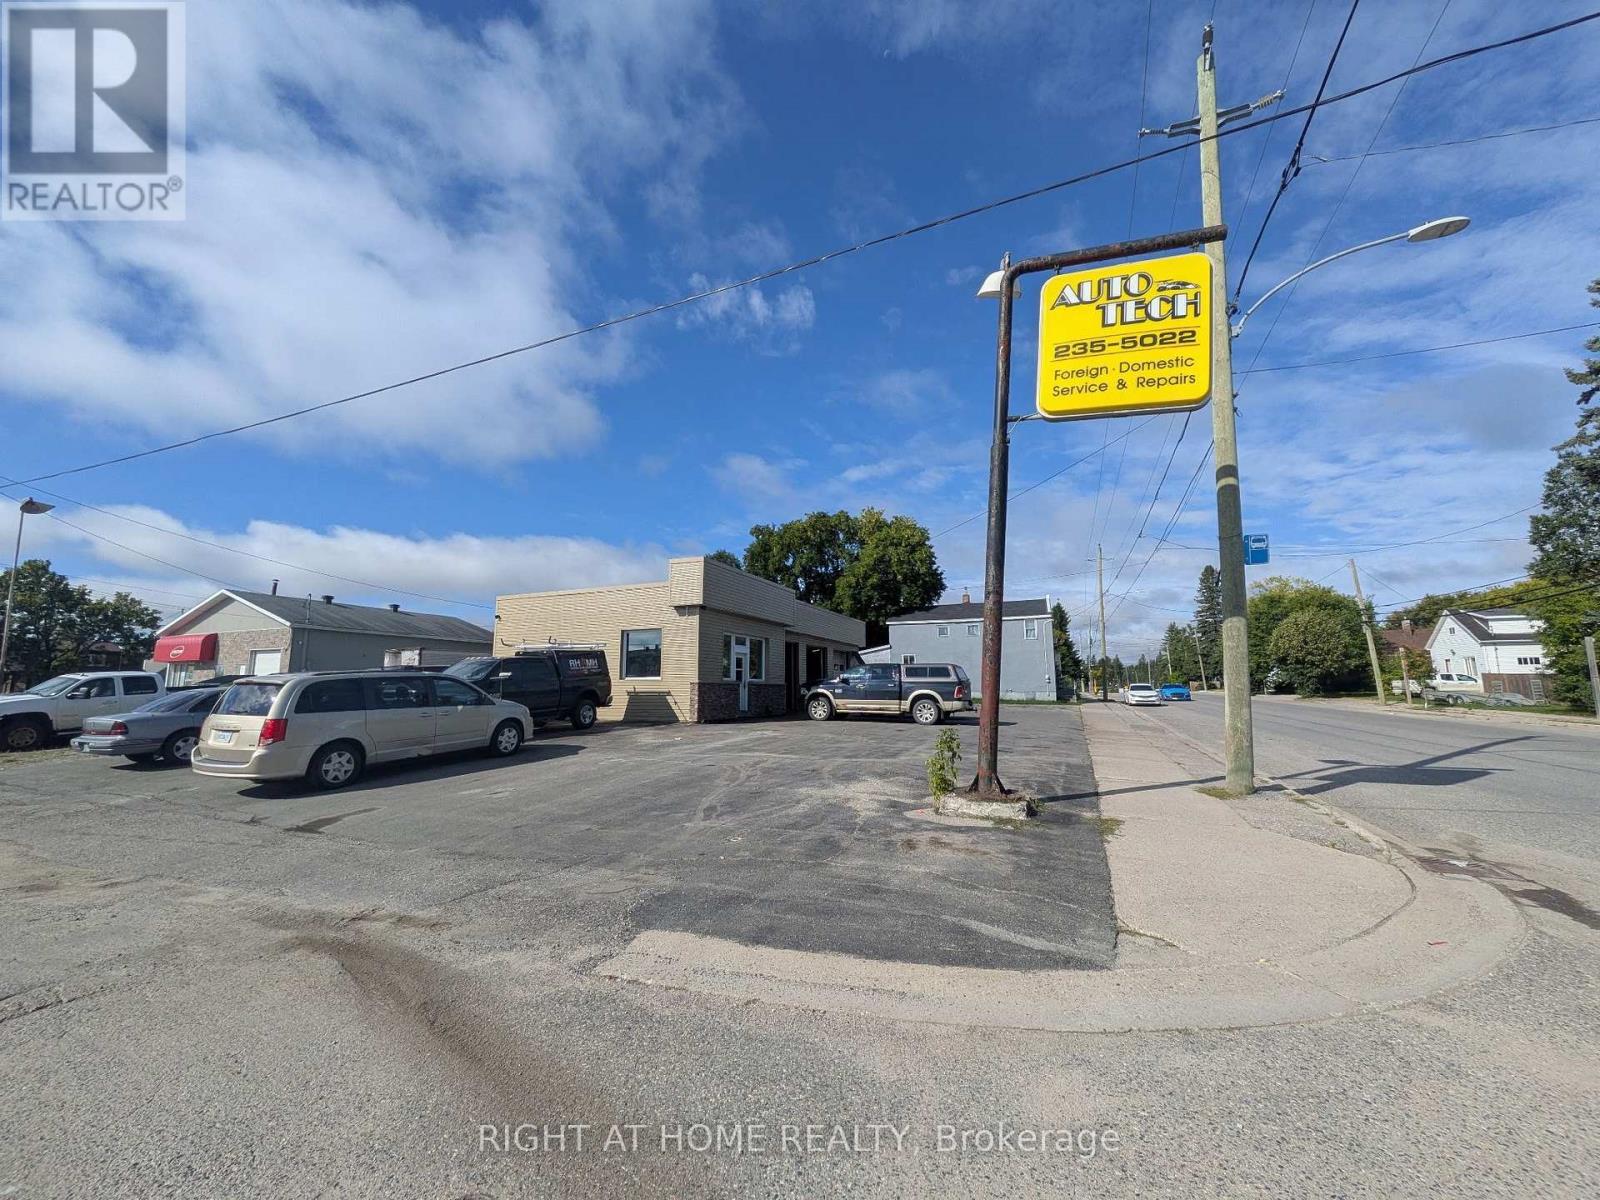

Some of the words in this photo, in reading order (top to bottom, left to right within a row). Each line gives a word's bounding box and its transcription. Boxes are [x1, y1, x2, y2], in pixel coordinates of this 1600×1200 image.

[1050, 272, 1153, 310] AUTO
[1096, 291, 1201, 328] TECH
[1054, 330, 1197, 359] 235-5022
[1054, 365, 1109, 381] Foreign
[1119, 356, 1195, 374] Domestic
[1053, 381, 1109, 397] Service
[1116, 378, 1128, 390] &
[1136, 373, 1196, 389] Repairs
